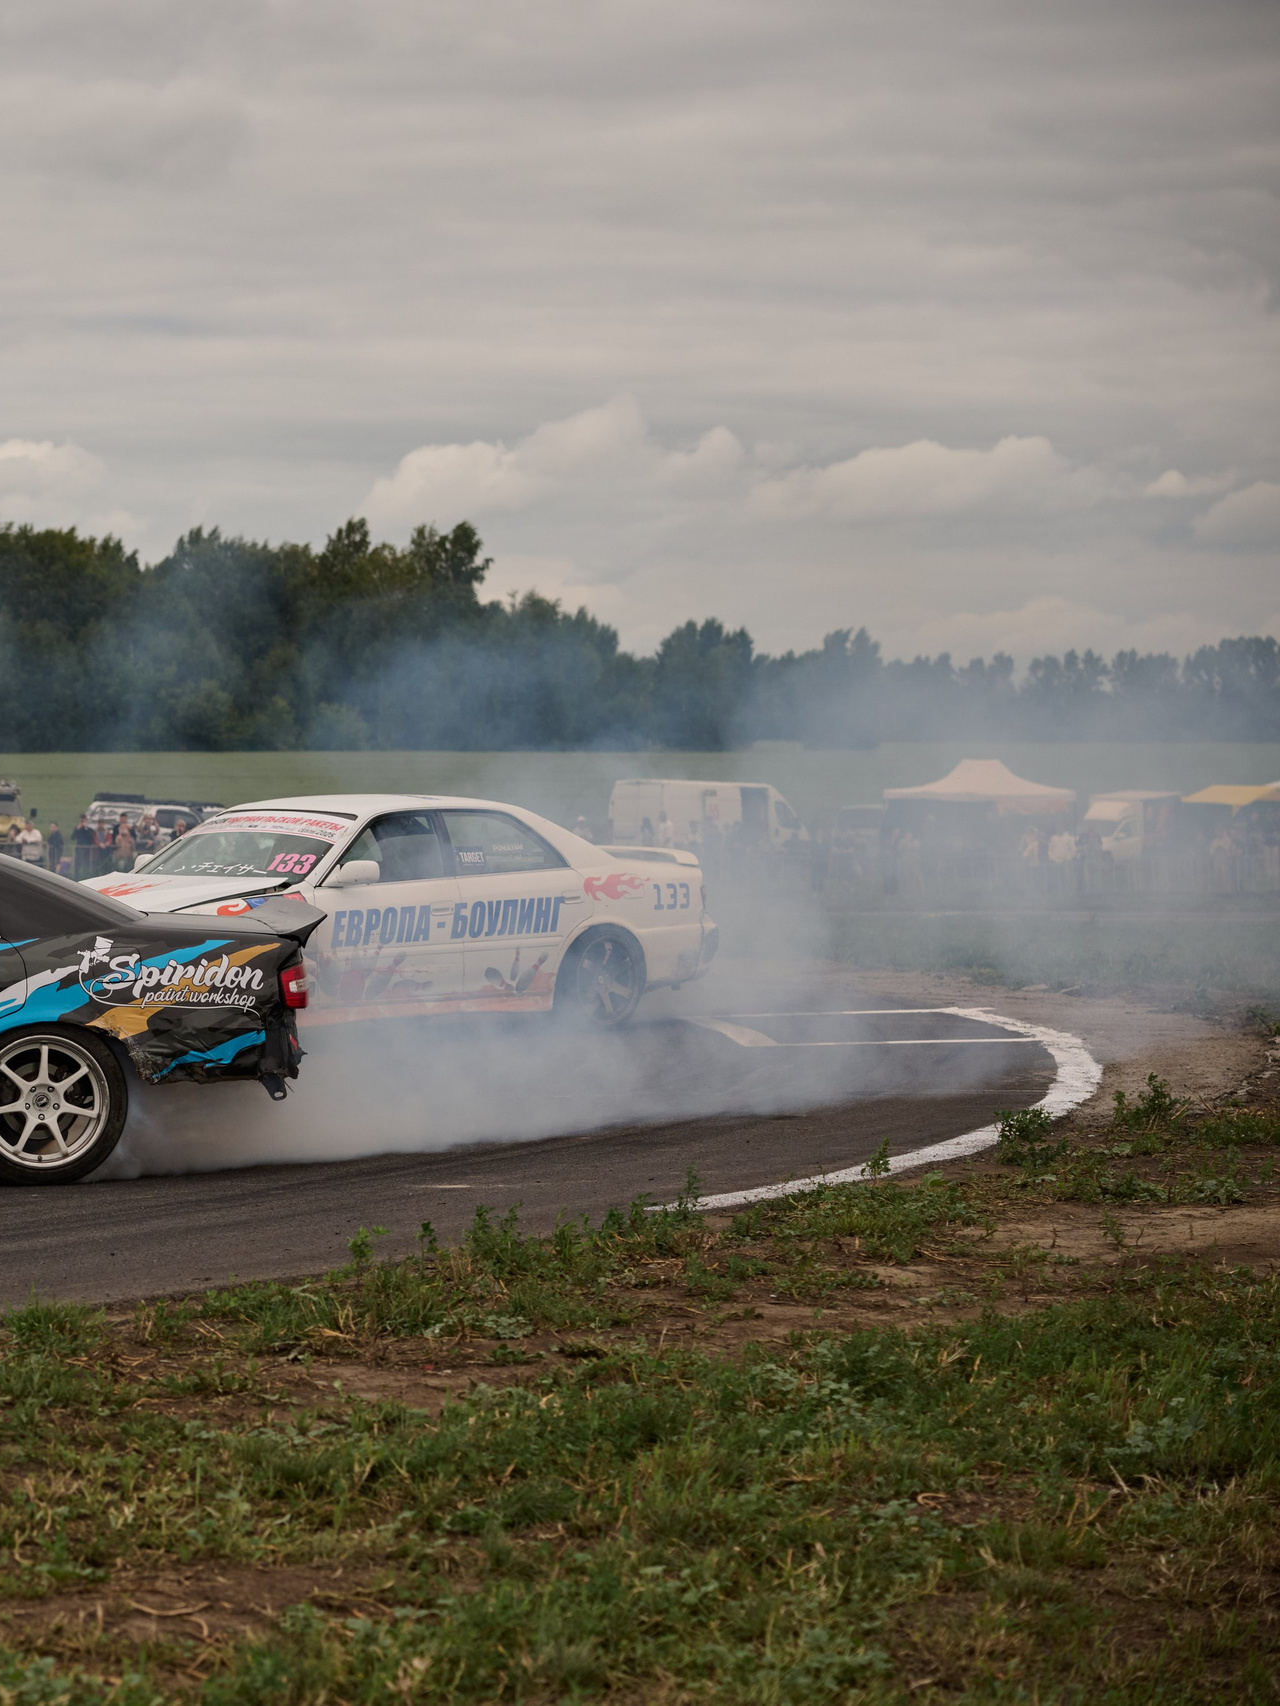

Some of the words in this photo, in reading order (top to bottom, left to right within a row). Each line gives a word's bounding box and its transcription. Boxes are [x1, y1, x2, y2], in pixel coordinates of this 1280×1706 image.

[301, 818, 346, 832] РАКЕТЫ
[267, 853, 317, 875] 133
[459, 851, 485, 863] TARGET
[653, 883, 690, 911] 133
[330, 904, 431, 948] ЕВРОПА
[450, 896, 565, 940] БОУЛИНГ
[101, 953, 264, 999] Spiridon
[140, 985, 190, 1009] paint
[190, 987, 256, 1013] workshop
